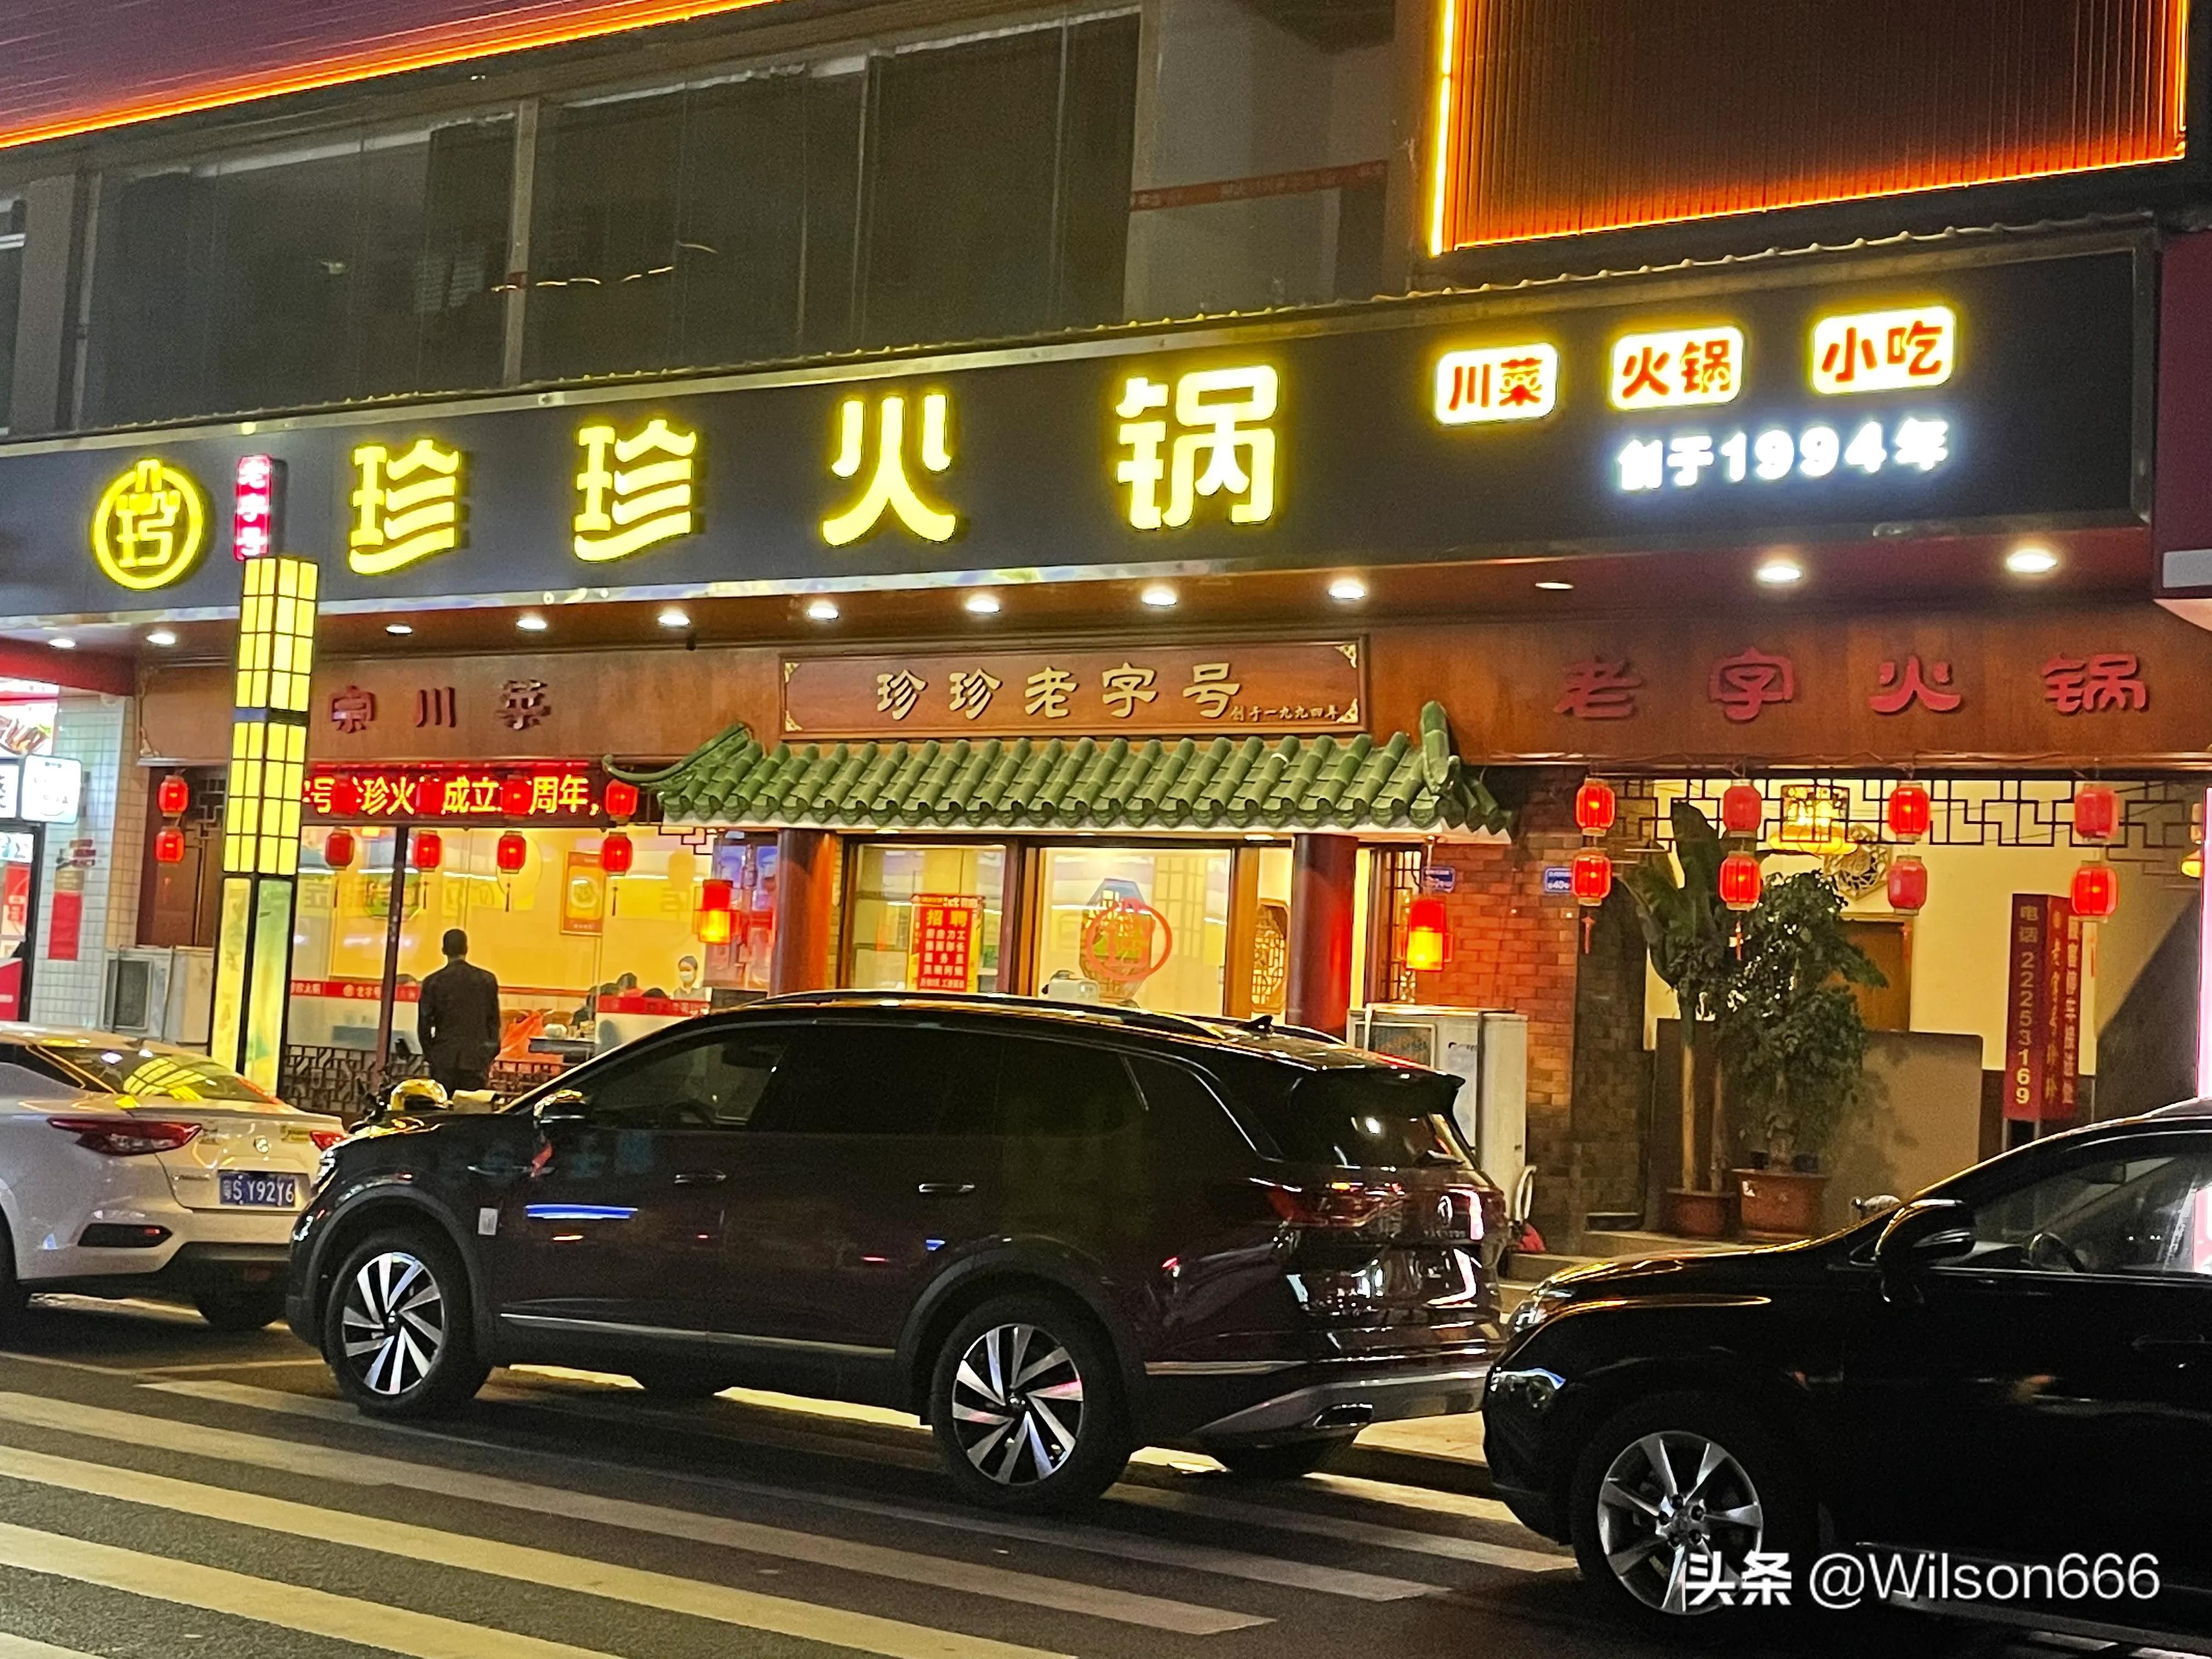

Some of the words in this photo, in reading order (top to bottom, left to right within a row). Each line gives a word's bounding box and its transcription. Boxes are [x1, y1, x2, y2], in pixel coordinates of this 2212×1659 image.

[1621, 339, 1731, 399] 火锅
[1821, 320, 1943, 383] 小吃
[1448, 357, 1543, 411] 川菜
[348, 364, 1278, 575] 珍珍火锅
[1617, 417, 1949, 492] 创于1994年
[877, 662, 1241, 720] 珍珍老字号
[1553, 646, 2149, 721] 老字火锅
